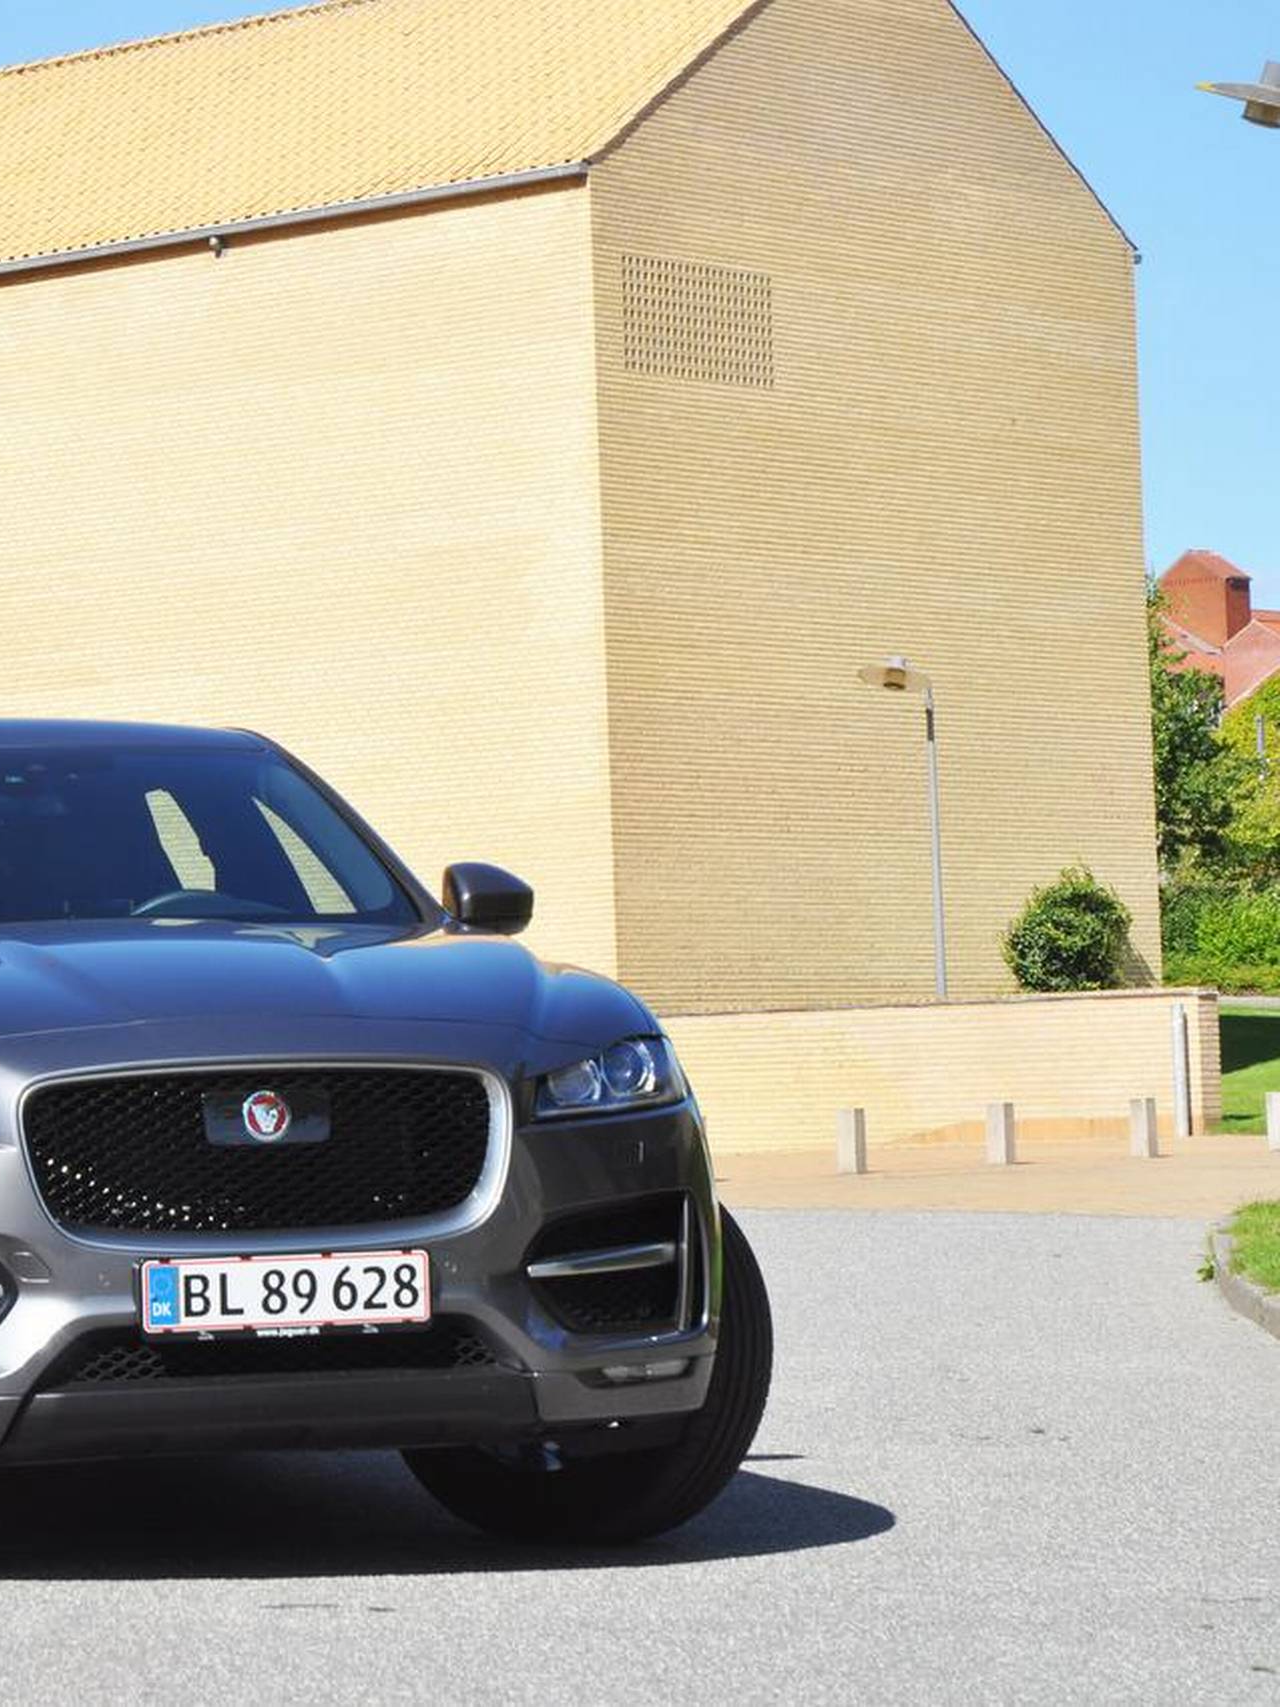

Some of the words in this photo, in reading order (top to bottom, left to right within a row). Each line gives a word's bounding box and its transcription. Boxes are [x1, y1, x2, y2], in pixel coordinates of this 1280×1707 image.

[183, 1273, 245, 1318] BL
[261, 1268, 318, 1315] 89
[332, 1263, 420, 1312] 628
[152, 1301, 172, 1317] DK
